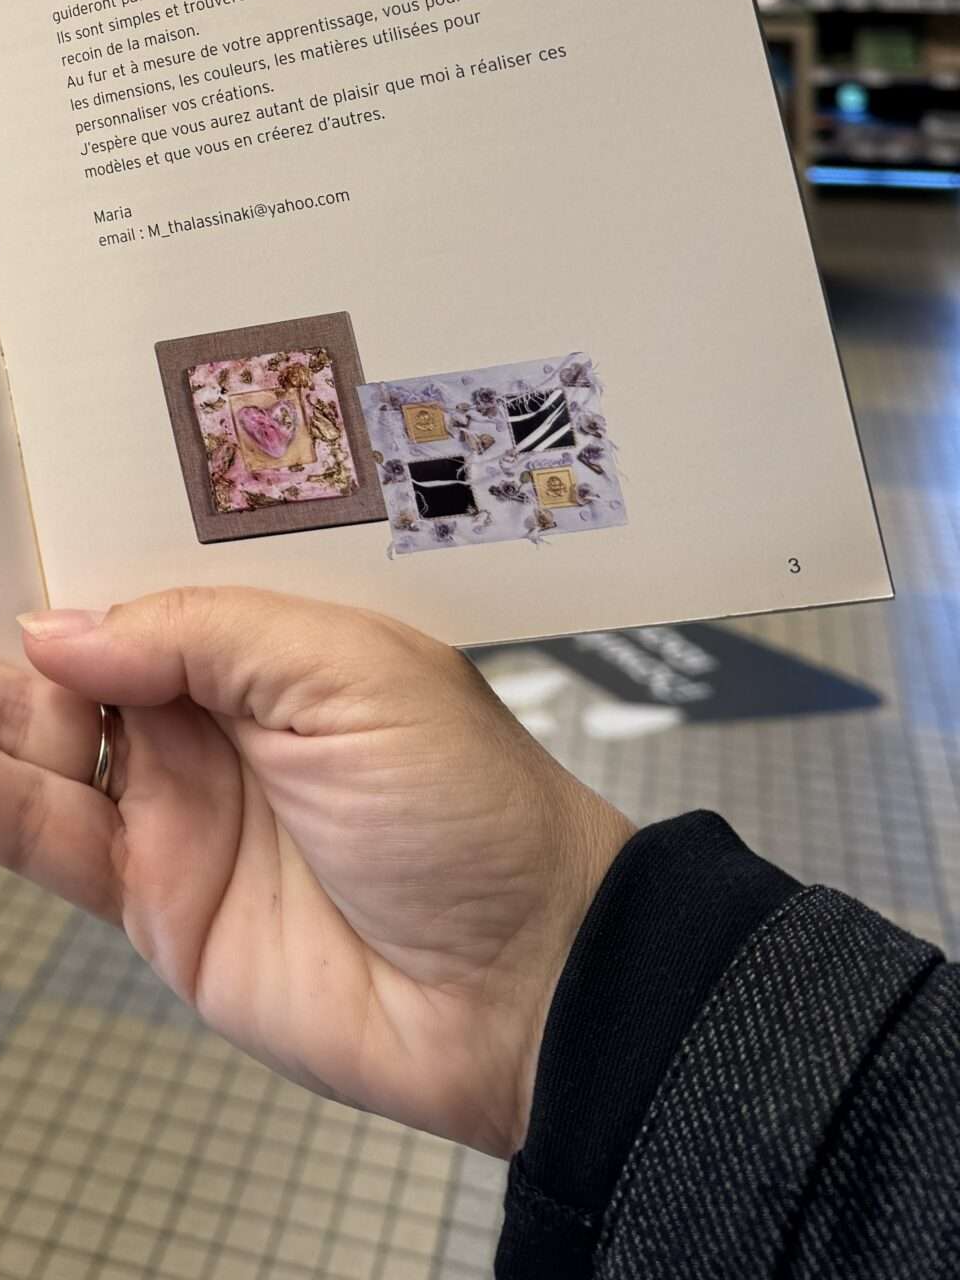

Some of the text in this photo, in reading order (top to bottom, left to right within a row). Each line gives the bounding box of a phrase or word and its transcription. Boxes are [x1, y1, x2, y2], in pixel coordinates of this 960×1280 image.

[84, 110, 385, 179] modèles et que vous en créerez d'autres.
[93, 206, 133, 224] Maria
[99, 228, 136, 247] email
[147, 191, 351, 239] M_thalassinaki@yahoo.com
[788, 558, 802, 574] 3
